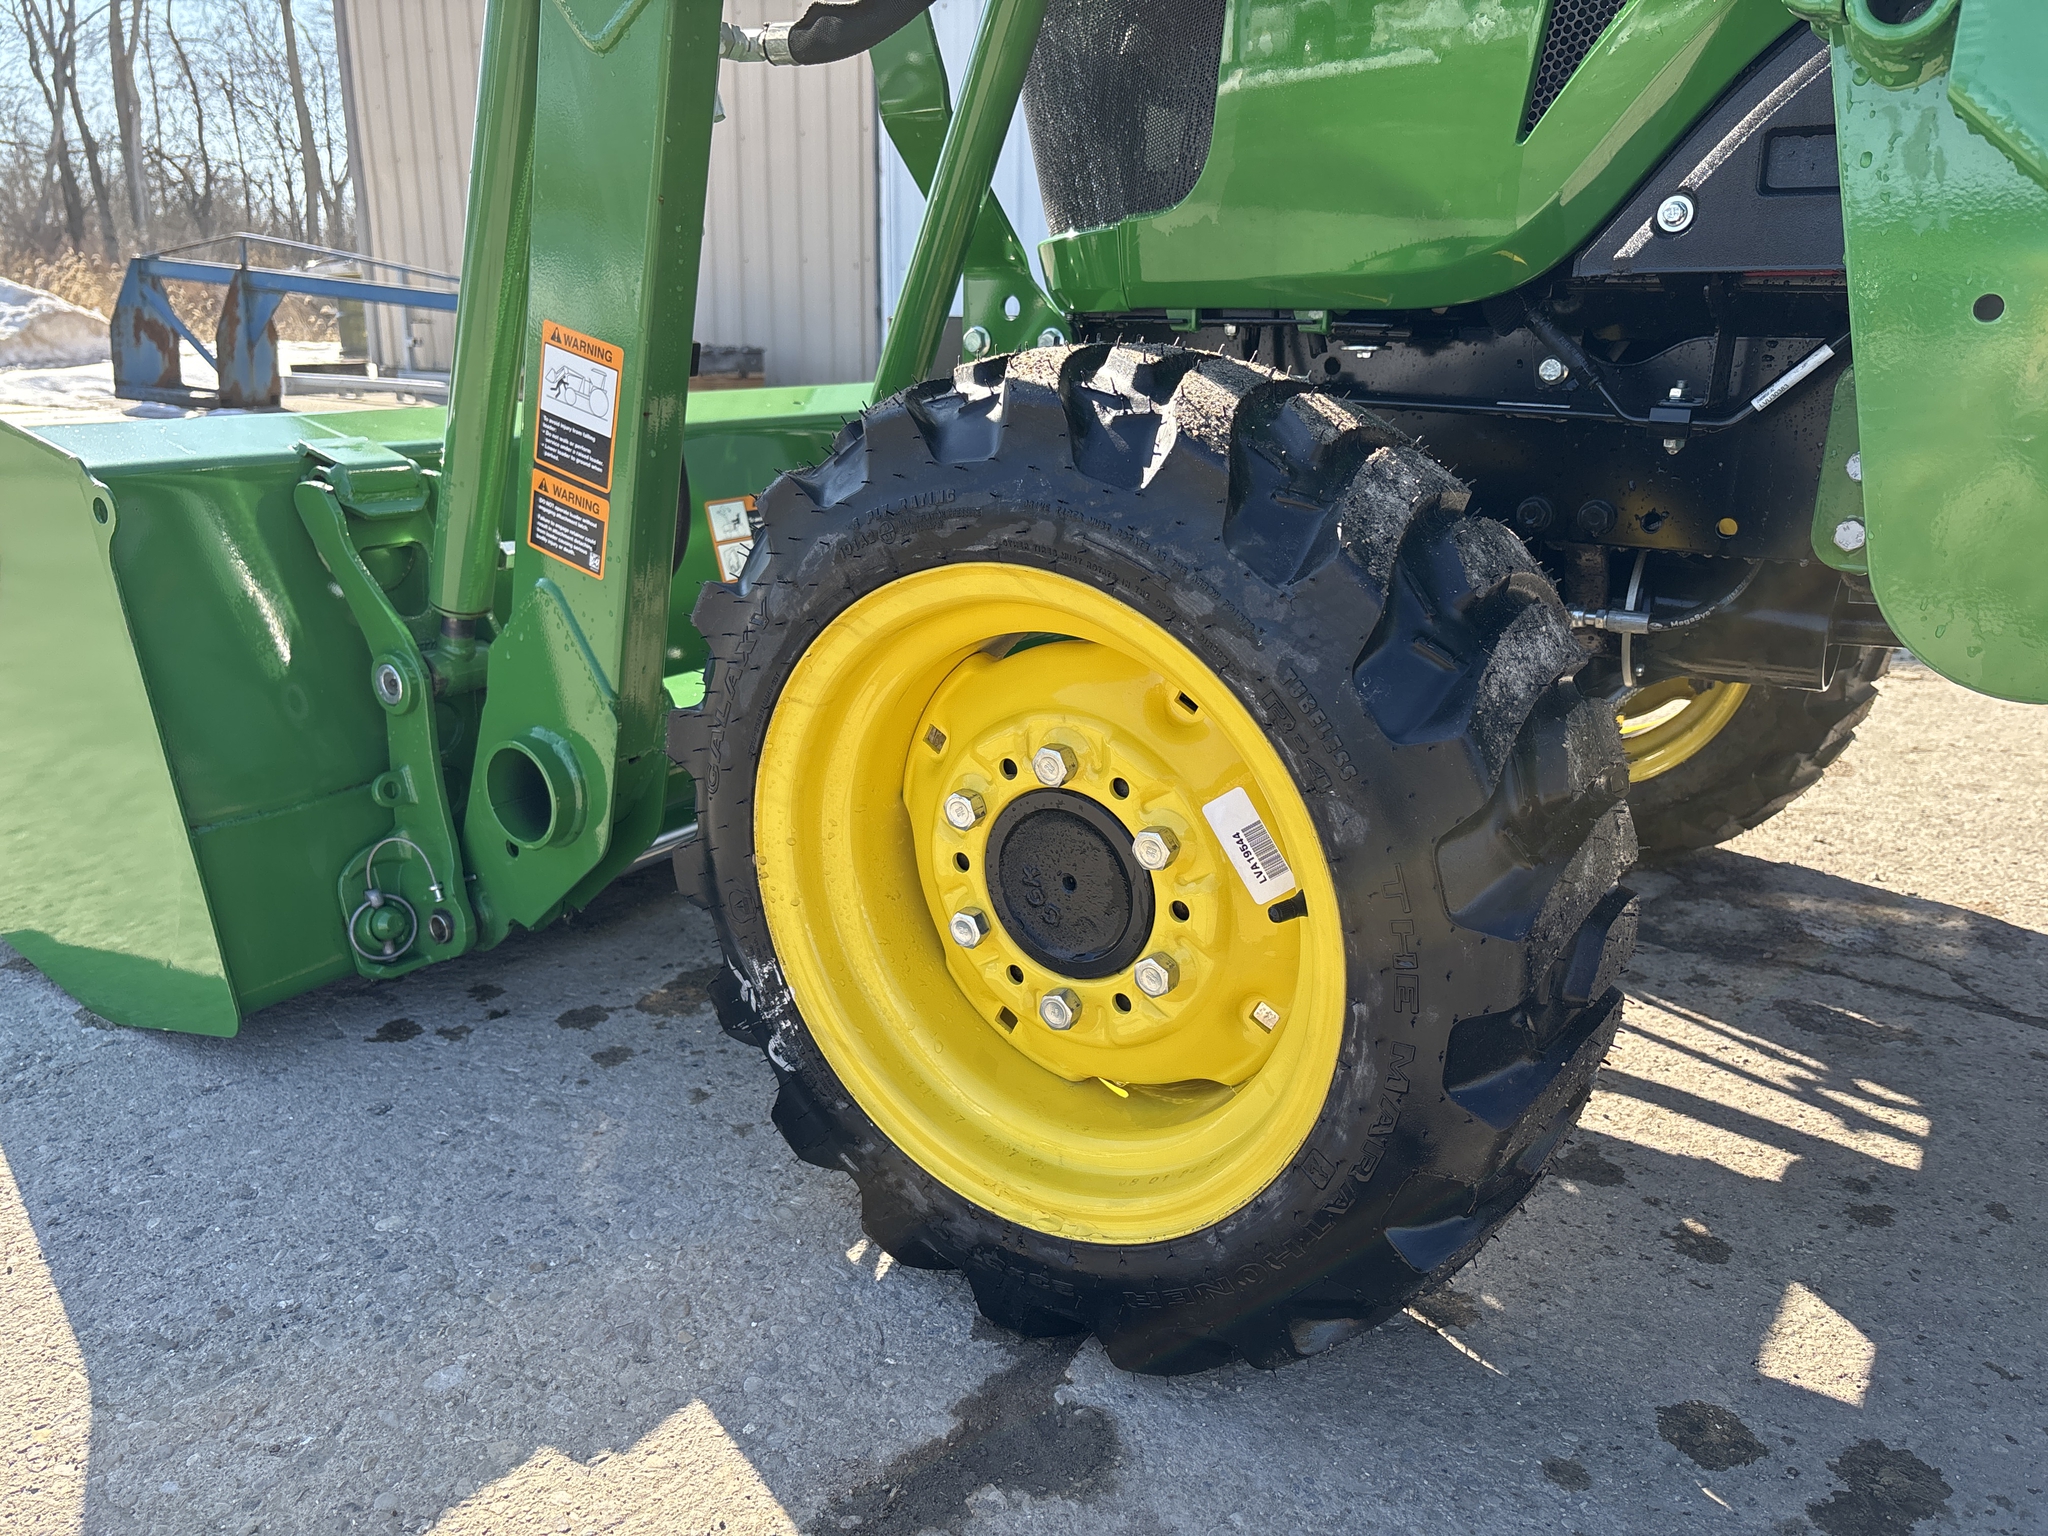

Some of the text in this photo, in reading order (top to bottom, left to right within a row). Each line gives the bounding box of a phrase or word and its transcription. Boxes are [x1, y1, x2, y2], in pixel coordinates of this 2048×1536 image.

[563, 333, 614, 363] WARNING
[542, 414, 595, 442] To avoid injury from falling
[545, 429, 551, 437] Do
[559, 436, 568, 444] walk
[574, 442, 591, 453] perform
[544, 443, 556, 452] Lower
[557, 449, 570, 458] loader
[575, 457, 590, 468] ground
[591, 464, 602, 473] when
[545, 437, 559, 446] service
[560, 443, 571, 452] under
[576, 450, 588, 459] raised
[589, 456, 603, 465] loader.
[538, 496, 597, 527] DO NOT operate loader without
[538, 504, 555, 516] engaging
[556, 512, 577, 525] attachment
[553, 484, 600, 515] WARNING
[898, 488, 956, 512] RATING
[535, 533, 547, 542] bodily
[547, 539, 557, 548] injury
[536, 520, 547, 529] result
[552, 527, 573, 540] attachment
[573, 537, 593, 550] detaching
[536, 527, 587, 553] from loader causing serious
[537, 513, 550, 522] Failure
[554, 522, 569, 532] engage
[569, 528, 584, 539] retainer
[584, 535, 596, 544] could
[1002, 539, 1029, 550] OTHER
[1032, 543, 1057, 557] TIRES
[1060, 551, 1082, 566] MUST
[1085, 560, 1116, 581] ROTATE
[1134, 584, 1151, 601] THE
[1191, 572, 1221, 601] ARROW
[704, 595, 770, 796] GALAXY
[1279, 667, 1358, 782] TUBELESS
[1232, 832, 1267, 884] LVA19544
[1381, 862, 1420, 1015] THE
[1122, 1041, 1417, 1310] MARATHONER
